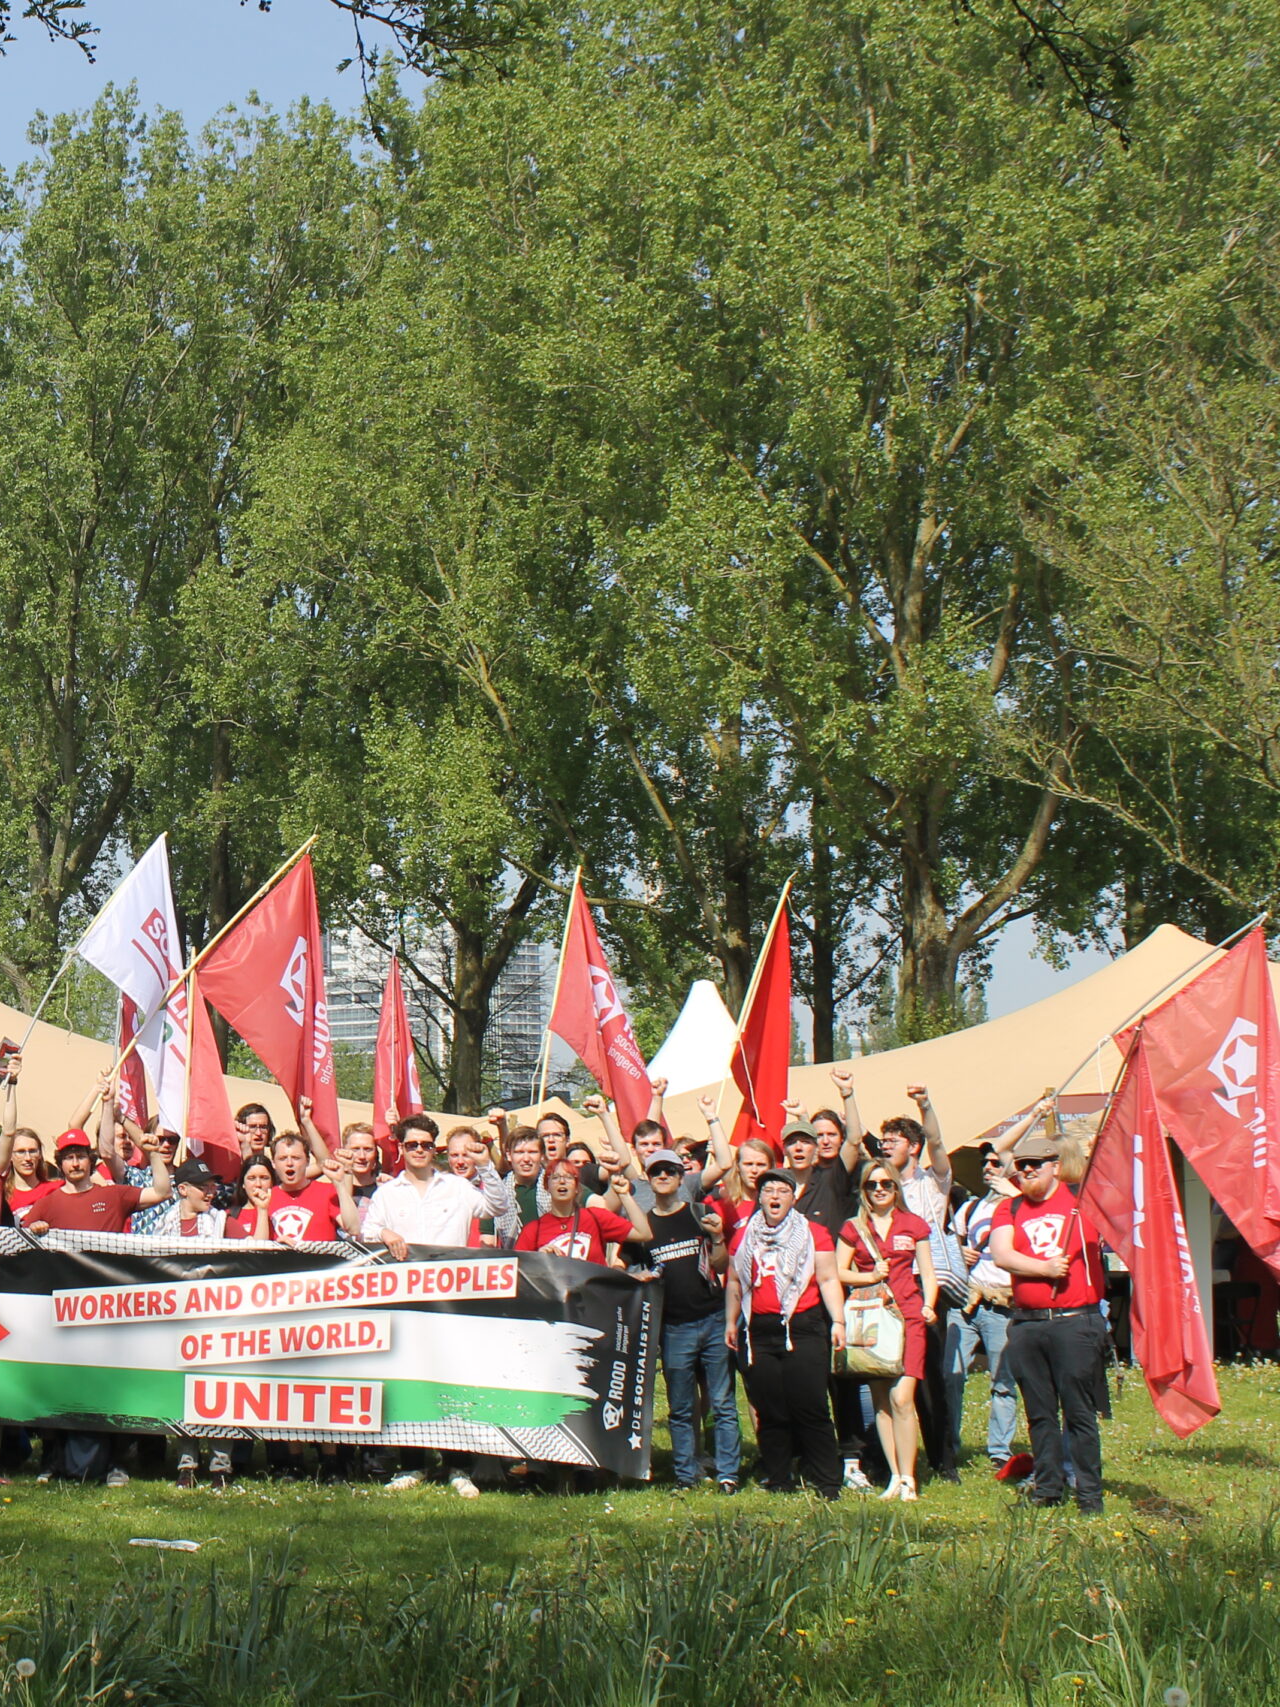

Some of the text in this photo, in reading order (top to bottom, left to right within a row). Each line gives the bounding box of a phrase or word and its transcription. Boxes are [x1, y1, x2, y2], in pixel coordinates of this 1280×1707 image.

[607, 1043, 642, 1080] jongeren
[55, 1263, 515, 1323] WORKERS AND OPPRESSED PEOPLES
[180, 1319, 384, 1362] OF THE WORLD,
[608, 1360, 627, 1401] ROOD
[631, 1301, 652, 1431] DE SOCIALISTEN
[193, 1380, 374, 1427] UNITE!
